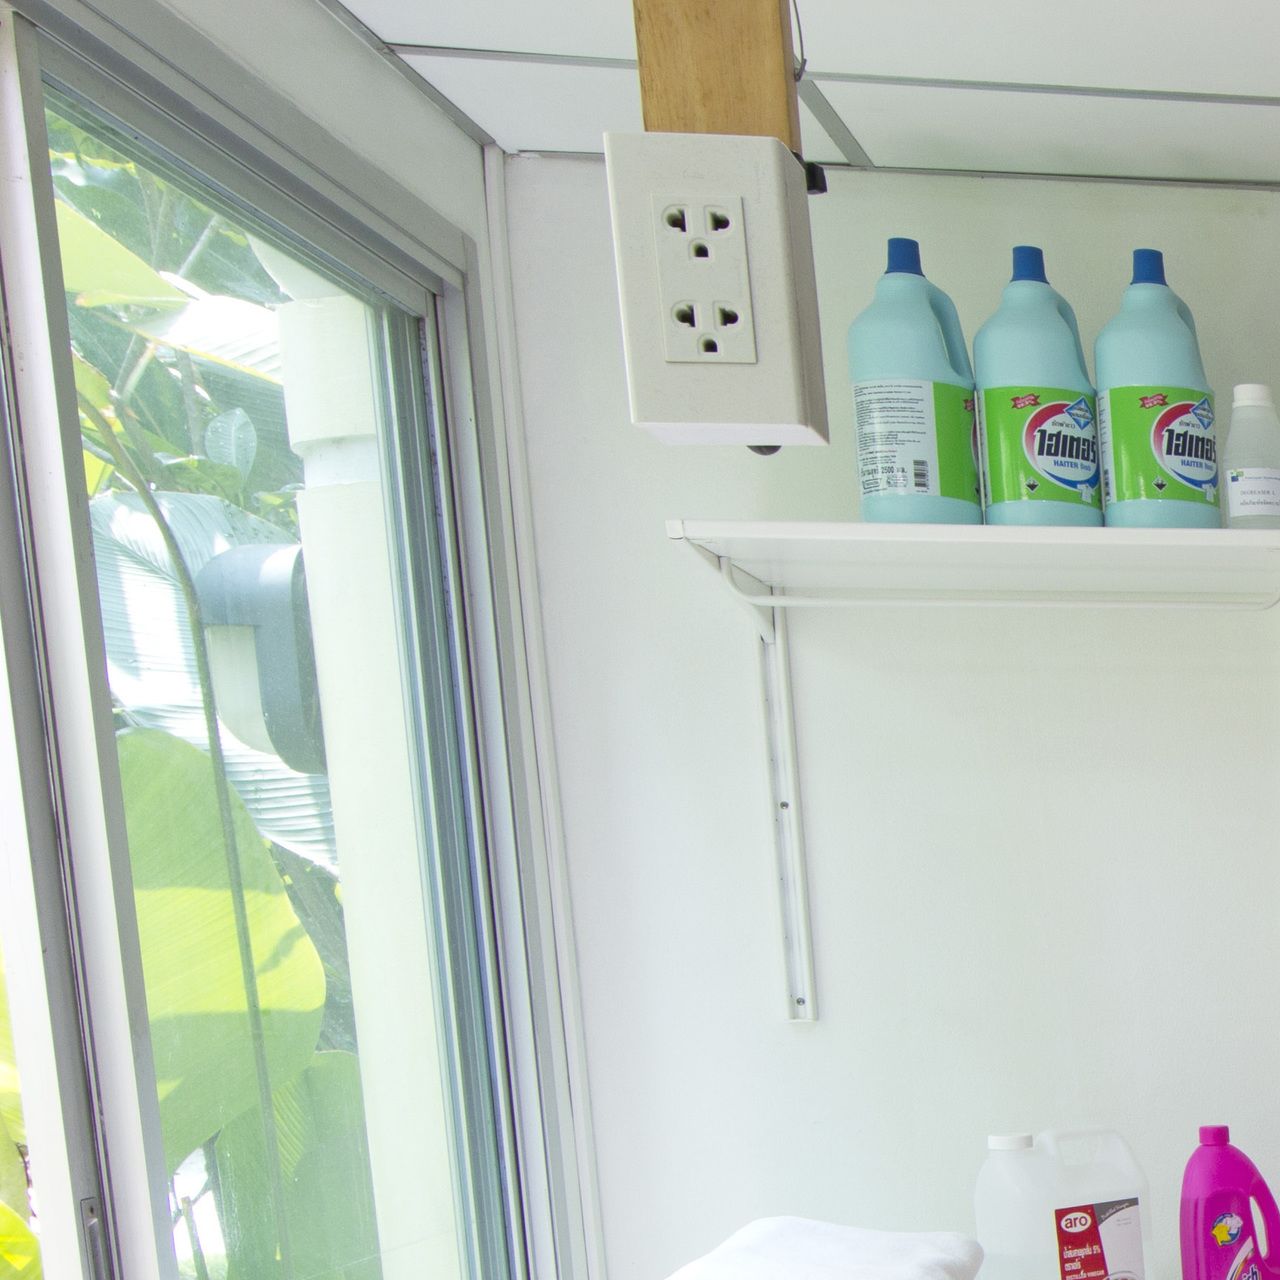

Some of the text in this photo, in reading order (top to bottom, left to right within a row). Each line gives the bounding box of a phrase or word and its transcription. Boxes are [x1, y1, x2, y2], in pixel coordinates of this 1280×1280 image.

[1037, 428, 1097, 465] ไฮเตอร์
[1053, 459, 1079, 469] HAITER
[1064, 1215, 1089, 1230] aro
